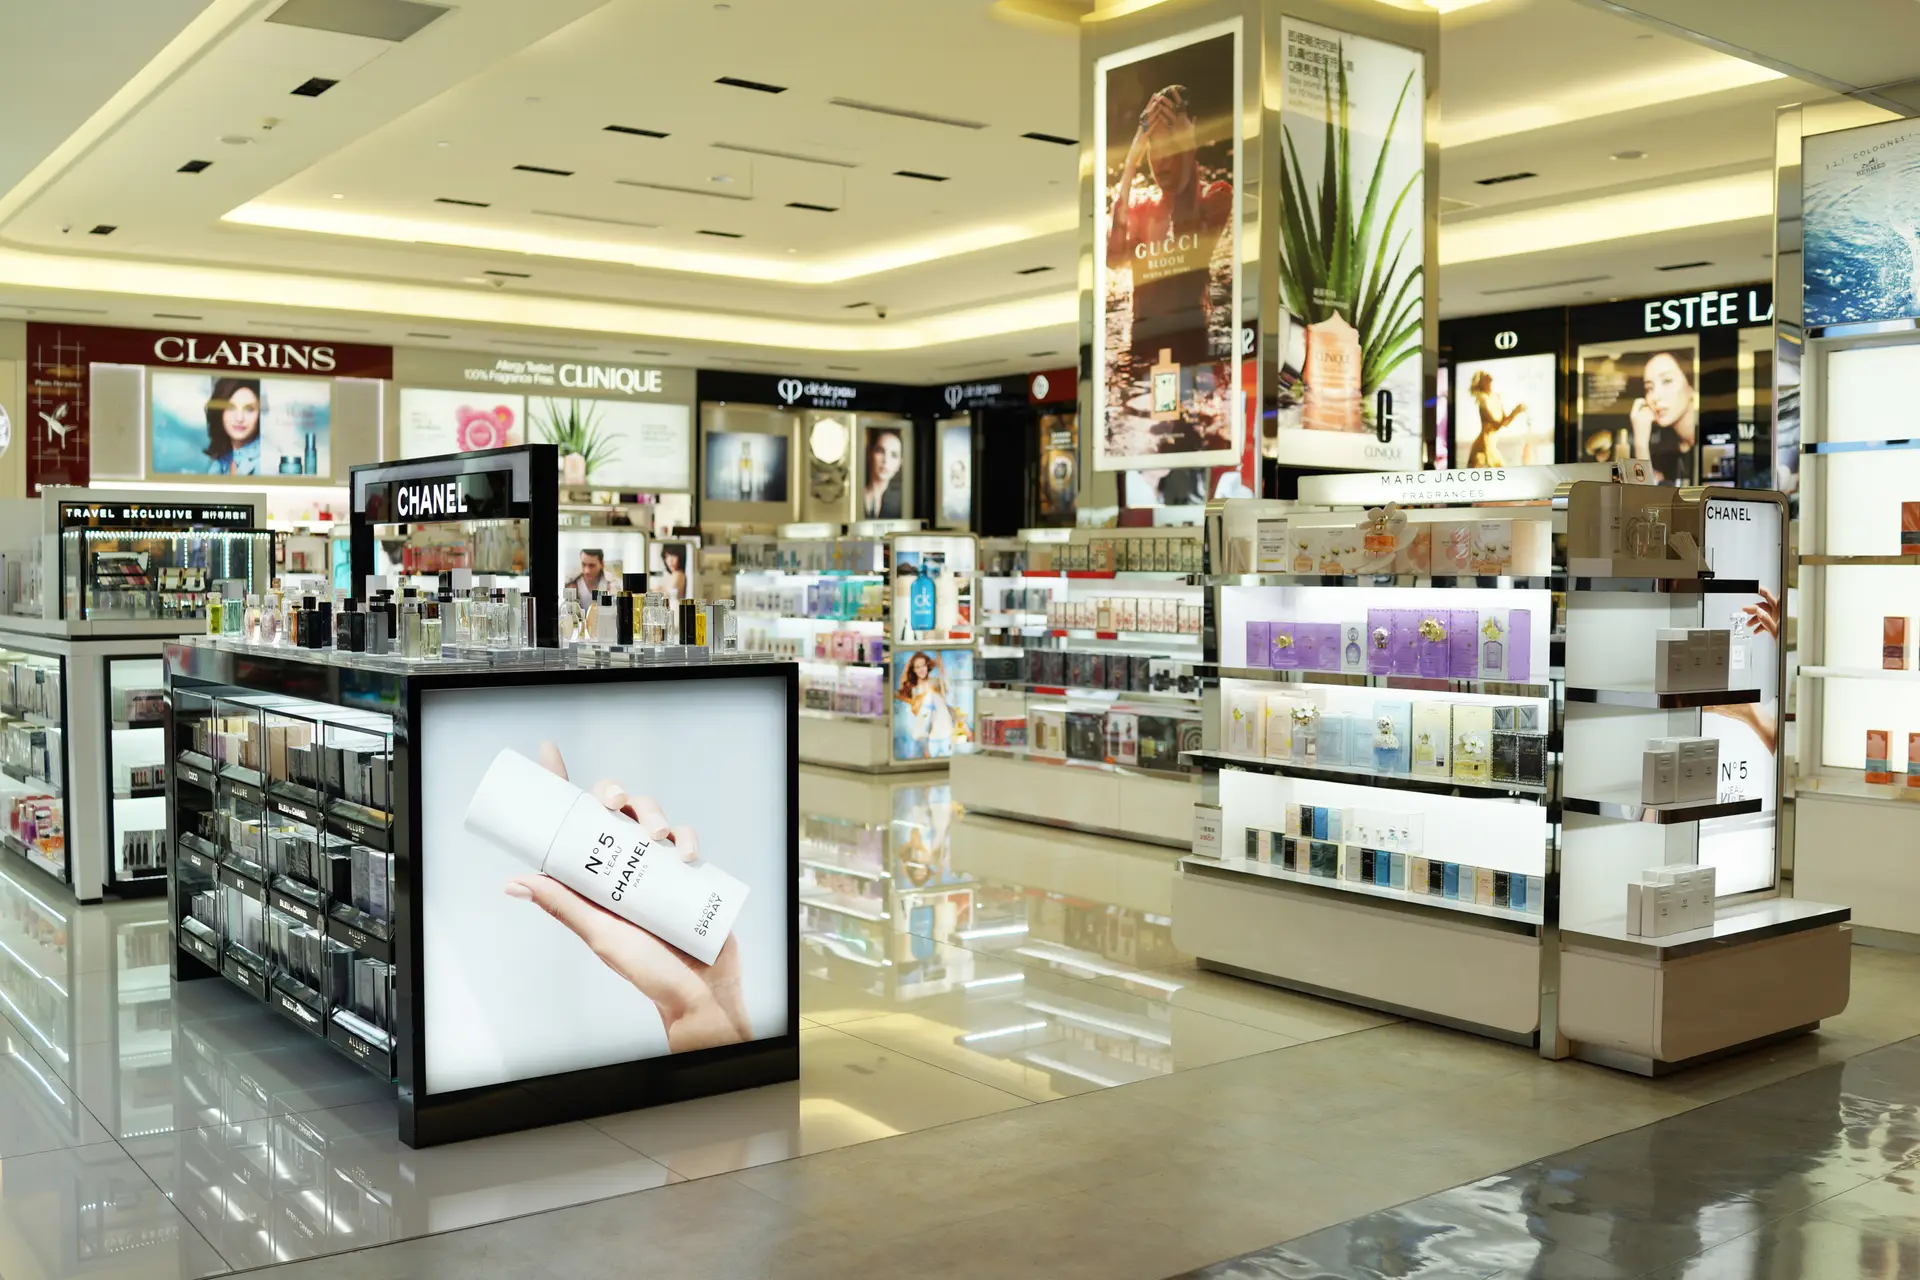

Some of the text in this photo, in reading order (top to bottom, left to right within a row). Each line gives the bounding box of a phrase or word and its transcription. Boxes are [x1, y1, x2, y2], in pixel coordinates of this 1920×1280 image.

[1853, 135, 1905, 160] COLOGNES
[1135, 233, 1198, 260] GUCCI
[154, 336, 337, 372] CLARINS
[559, 364, 662, 394] CLINIQUE
[1381, 470, 1507, 486] MARC JACOBS
[397, 482, 468, 517] CHANEL
[1402, 489, 1485, 500] FRAGRANCES
[66, 508, 193, 519] TRAVEL EXCLUSIVE
[1706, 506, 1751, 522] CHANEL
[231, 785, 248, 798] ALLURE
[278, 802, 290, 814] BLEU
[346, 821, 365, 835] ALLURE
[603, 845, 623, 876] L'EAU
[611, 840, 650, 902] CHANEL
[634, 863, 649, 889] PARIS
[279, 898, 291, 911] BLEU
[693, 891, 718, 933] ALL-OVER
[699, 895, 723, 937] SPRAY
[348, 928, 367, 943] ALLURE
[348, 1036, 370, 1056] ALLURE
